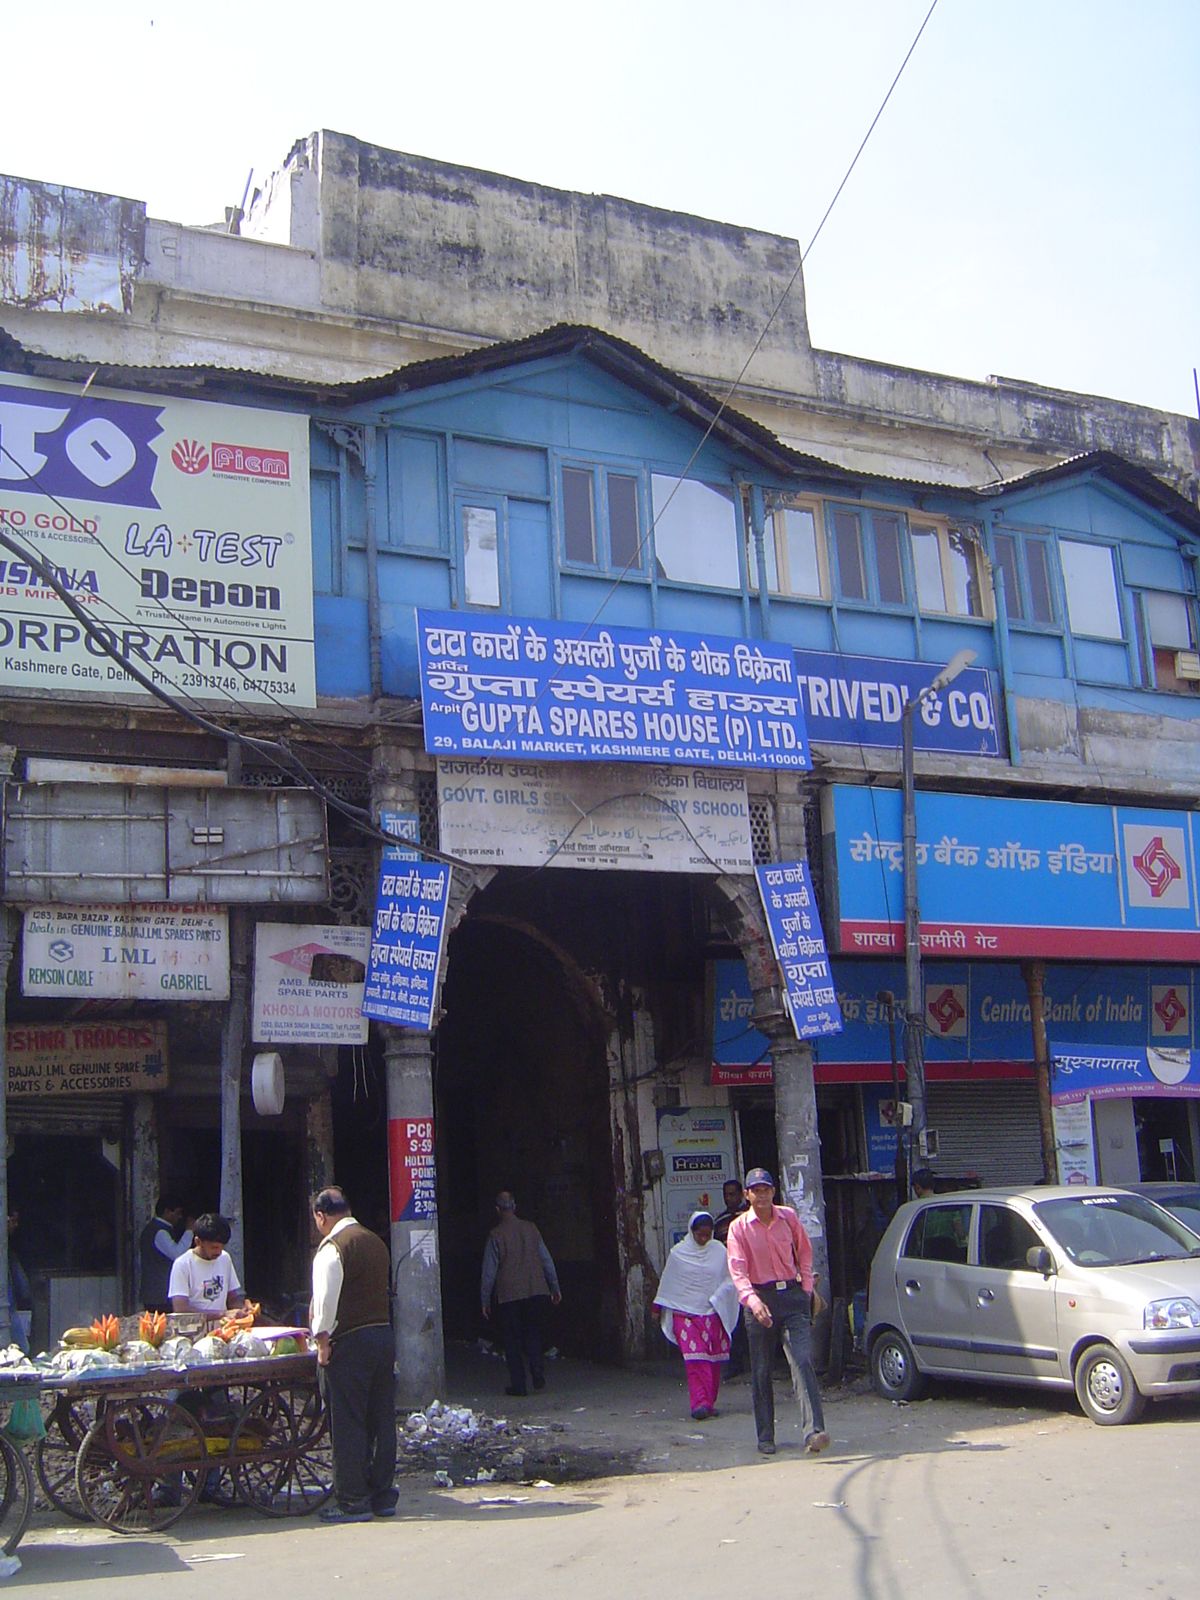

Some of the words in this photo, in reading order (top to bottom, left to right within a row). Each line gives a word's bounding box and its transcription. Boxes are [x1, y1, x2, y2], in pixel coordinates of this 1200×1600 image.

[212, 472, 250, 483] AUTOMOTIVE
[251, 478, 291, 487] COMPONENTS
[34, 513, 98, 534] GOLD
[125, 523, 172, 558] LA
[193, 530, 282, 568] TEST
[25, 589, 100, 605] MIROR
[140, 568, 281, 611] Depon
[145, 611, 176, 620] Trusted
[178, 614, 201, 622] Name
[204, 616, 212, 624] In
[213, 618, 260, 628] Automotive
[262, 621, 287, 631] Lights
[425, 628, 466, 657] टाटा
[471, 624, 522, 661] कारों
[523, 626, 547, 663] के
[553, 631, 616, 669] असली
[665, 637, 686, 673] के
[691, 640, 730, 676] थोक
[734, 644, 792, 684] विक्रेता
[5, 657, 68, 675] Kashmere
[71, 663, 103, 680] Gate,
[182, 673, 240, 693] 23913746,
[243, 678, 296, 695] 64775334
[427, 660, 469, 672] अर्पित
[426, 671, 539, 701] गुप्ता
[549, 674, 675, 707] स्पेयर्स
[685, 688, 798, 716] हाऊस
[948, 690, 994, 731] CO.
[430, 702, 460, 714] Arpit
[461, 701, 544, 736] GUPTA
[550, 706, 638, 740] SPARES
[643, 711, 720, 744] HOUSE
[724, 713, 752, 750] (P)
[757, 719, 802, 750] LTD.
[434, 736, 458, 749] 29,
[462, 737, 517, 751] BALAJI
[521, 741, 587, 755] MARKET,
[591, 744, 670, 757] KASHMERE
[674, 748, 715, 760] GATE,
[718, 750, 806, 765] DELHI-110006
[693, 770, 745, 792] विद्यालय
[442, 786, 488, 804] GOVT.
[493, 789, 539, 805] GIRLS
[693, 801, 747, 817] SCHOOL
[689, 857, 712, 865] SCHOOL
[723, 858, 737, 866] THIS
[934, 835, 980, 869] बैंक
[1047, 843, 1113, 875] इंडिया
[765, 869, 784, 885] टाटा
[784, 863, 805, 883] कारों
[382, 875, 396, 896] टाटा
[412, 870, 421, 898] के
[421, 870, 445, 901] असली
[771, 891, 783, 909] के
[783, 886, 810, 909] असली
[57, 912, 78, 921] BARA
[113, 915, 152, 924] KASHMIRI
[181, 918, 214, 927] DELHI-6
[800, 911, 811, 930] के
[27, 921, 55, 933] Deals
[56, 926, 66, 934] in
[165, 928, 195, 941] SPARES
[196, 929, 222, 942] PARTS
[976, 931, 998, 949] गेट
[101, 947, 156, 965] LML
[371, 943, 390, 968] गुप्ता
[413, 949, 437, 971] हाऊस
[778, 938, 799, 959] थोक
[29, 968, 65, 985] REMSON
[66, 970, 93, 986] CABLE
[160, 974, 212, 991] GABRIEL
[785, 961, 827, 986] गुप्ता
[278, 988, 312, 997] SPARE
[315, 989, 348, 999] PARTS
[813, 987, 835, 1007] हाऊस
[262, 1003, 310, 1017] KHOSLA
[313, 1006, 361, 1019] MOTORS
[981, 996, 1032, 1023] Centra
[1043, 996, 1081, 1022] Bank
[1086, 995, 1103, 1022] of
[1105, 998, 1143, 1022] India
[72, 1027, 152, 1050] TRADERS
[69, 1063, 111, 1075] GENUINE
[114, 1061, 140, 1073] SPARE
[1054, 1055, 1143, 1077] सुस्वागतम्
[8, 1080, 41, 1092] PARTS
[45, 1080, 55, 1091] &
[60, 1076, 132, 1090] ACCESSORIES
[406, 1123, 432, 1138] PCR
